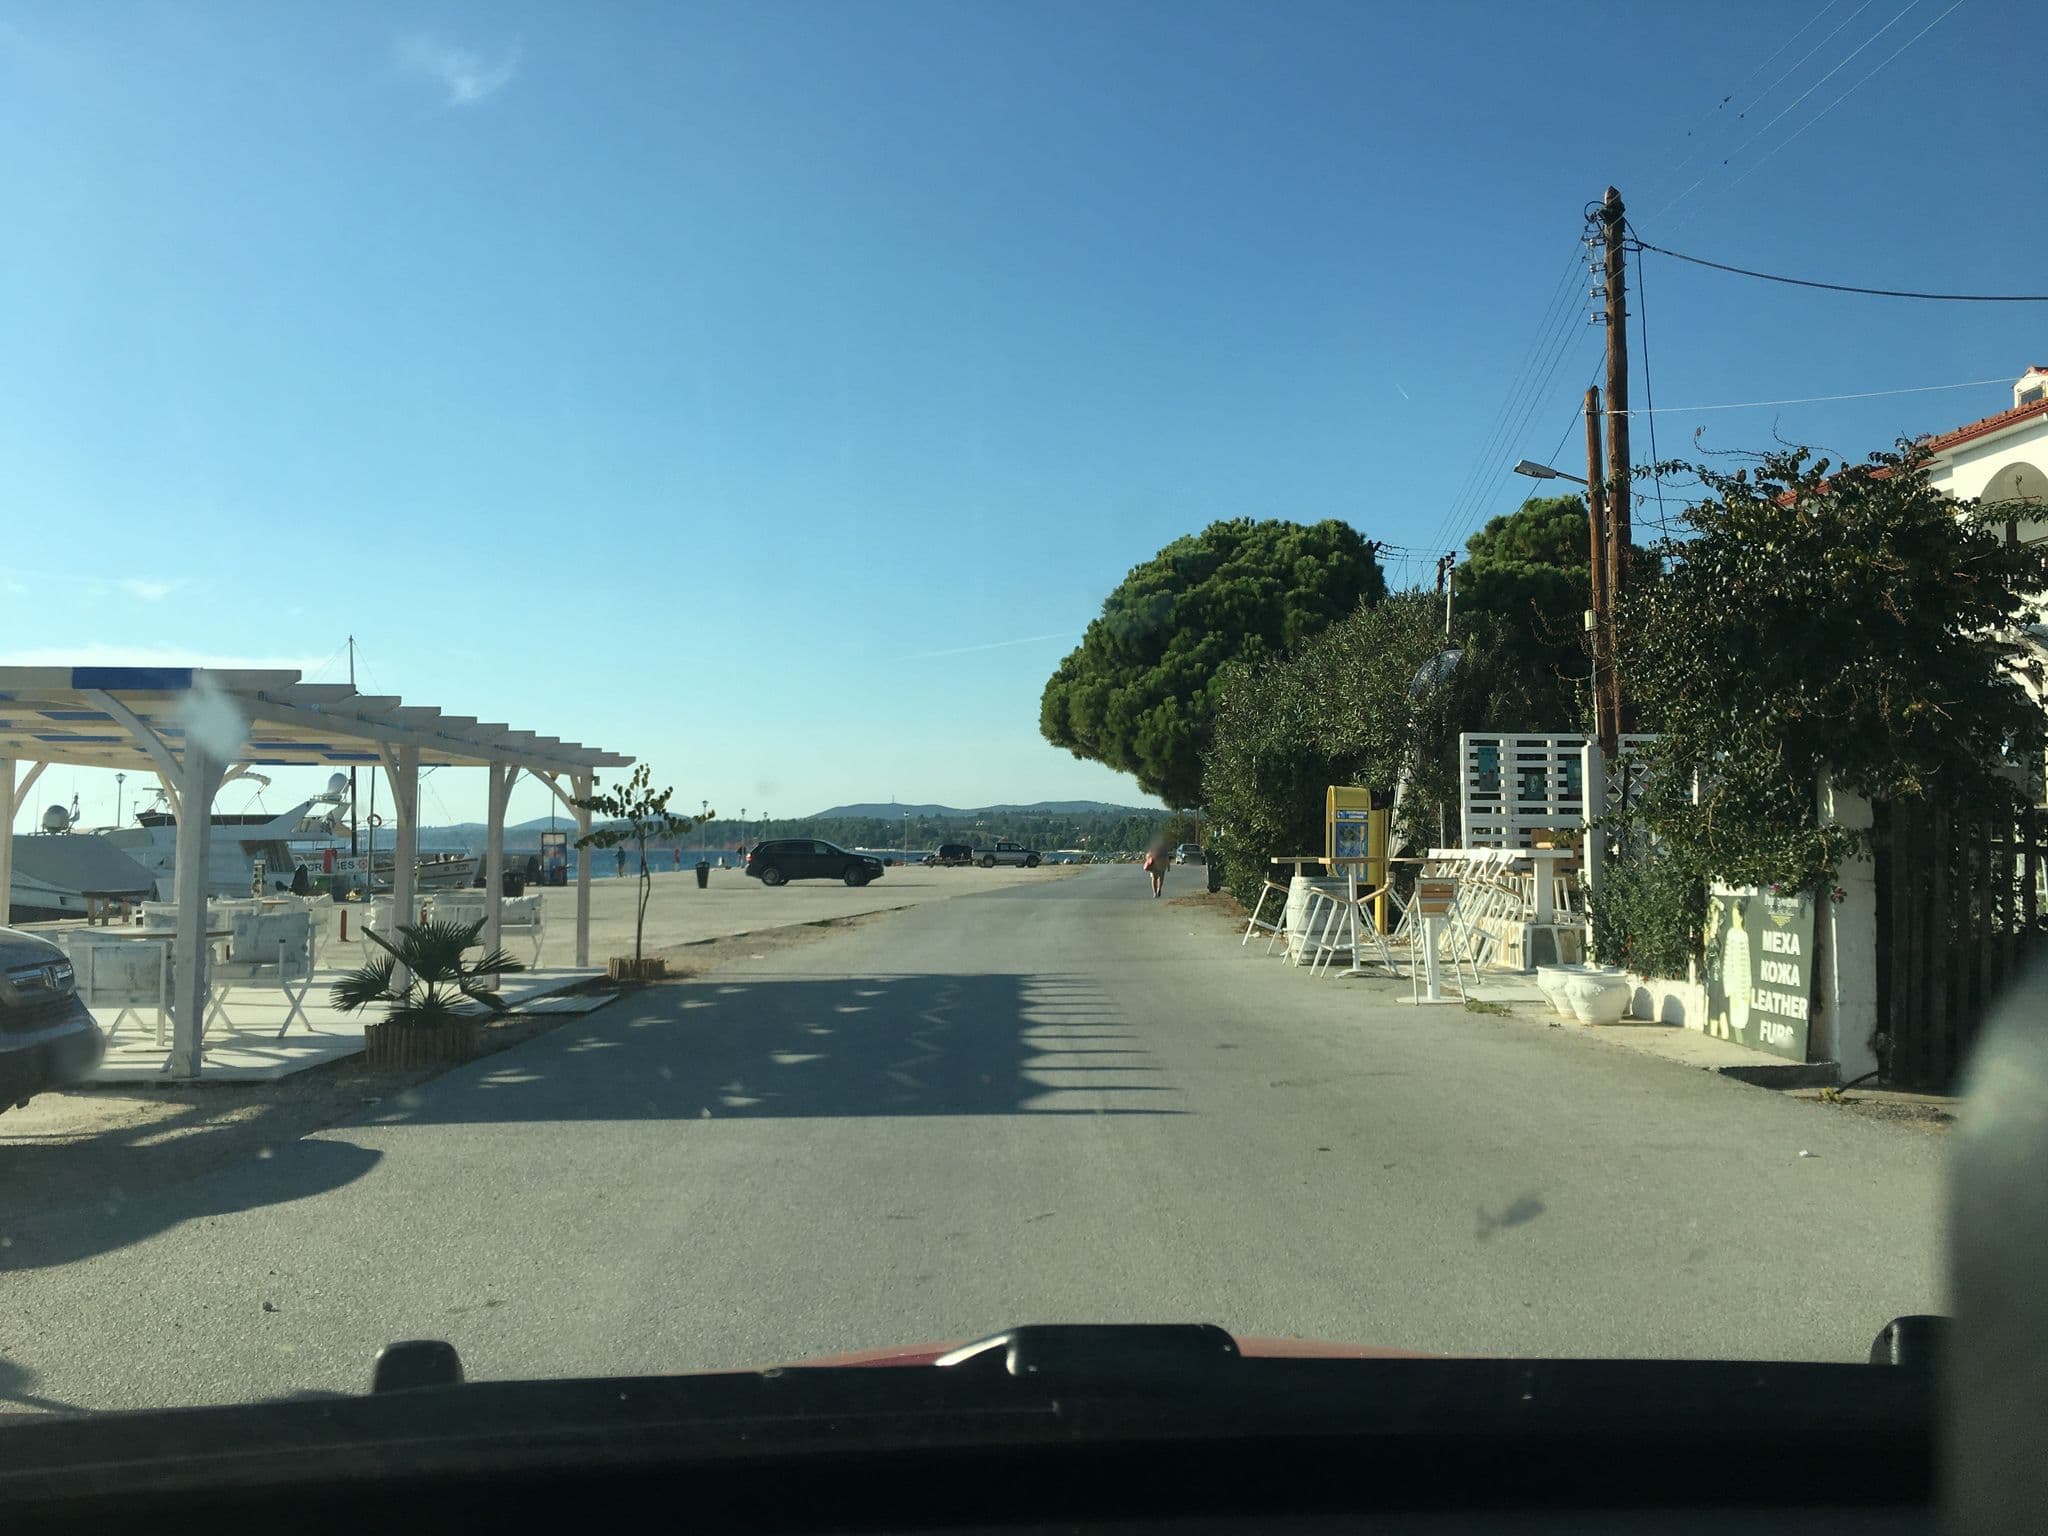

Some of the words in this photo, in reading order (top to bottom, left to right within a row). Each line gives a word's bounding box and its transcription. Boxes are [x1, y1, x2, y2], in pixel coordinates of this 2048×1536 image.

[1762, 930, 1801, 956] МЕХА
[1760, 960, 1801, 987] КОЖА
[1751, 988, 1808, 1020] LEATHER
